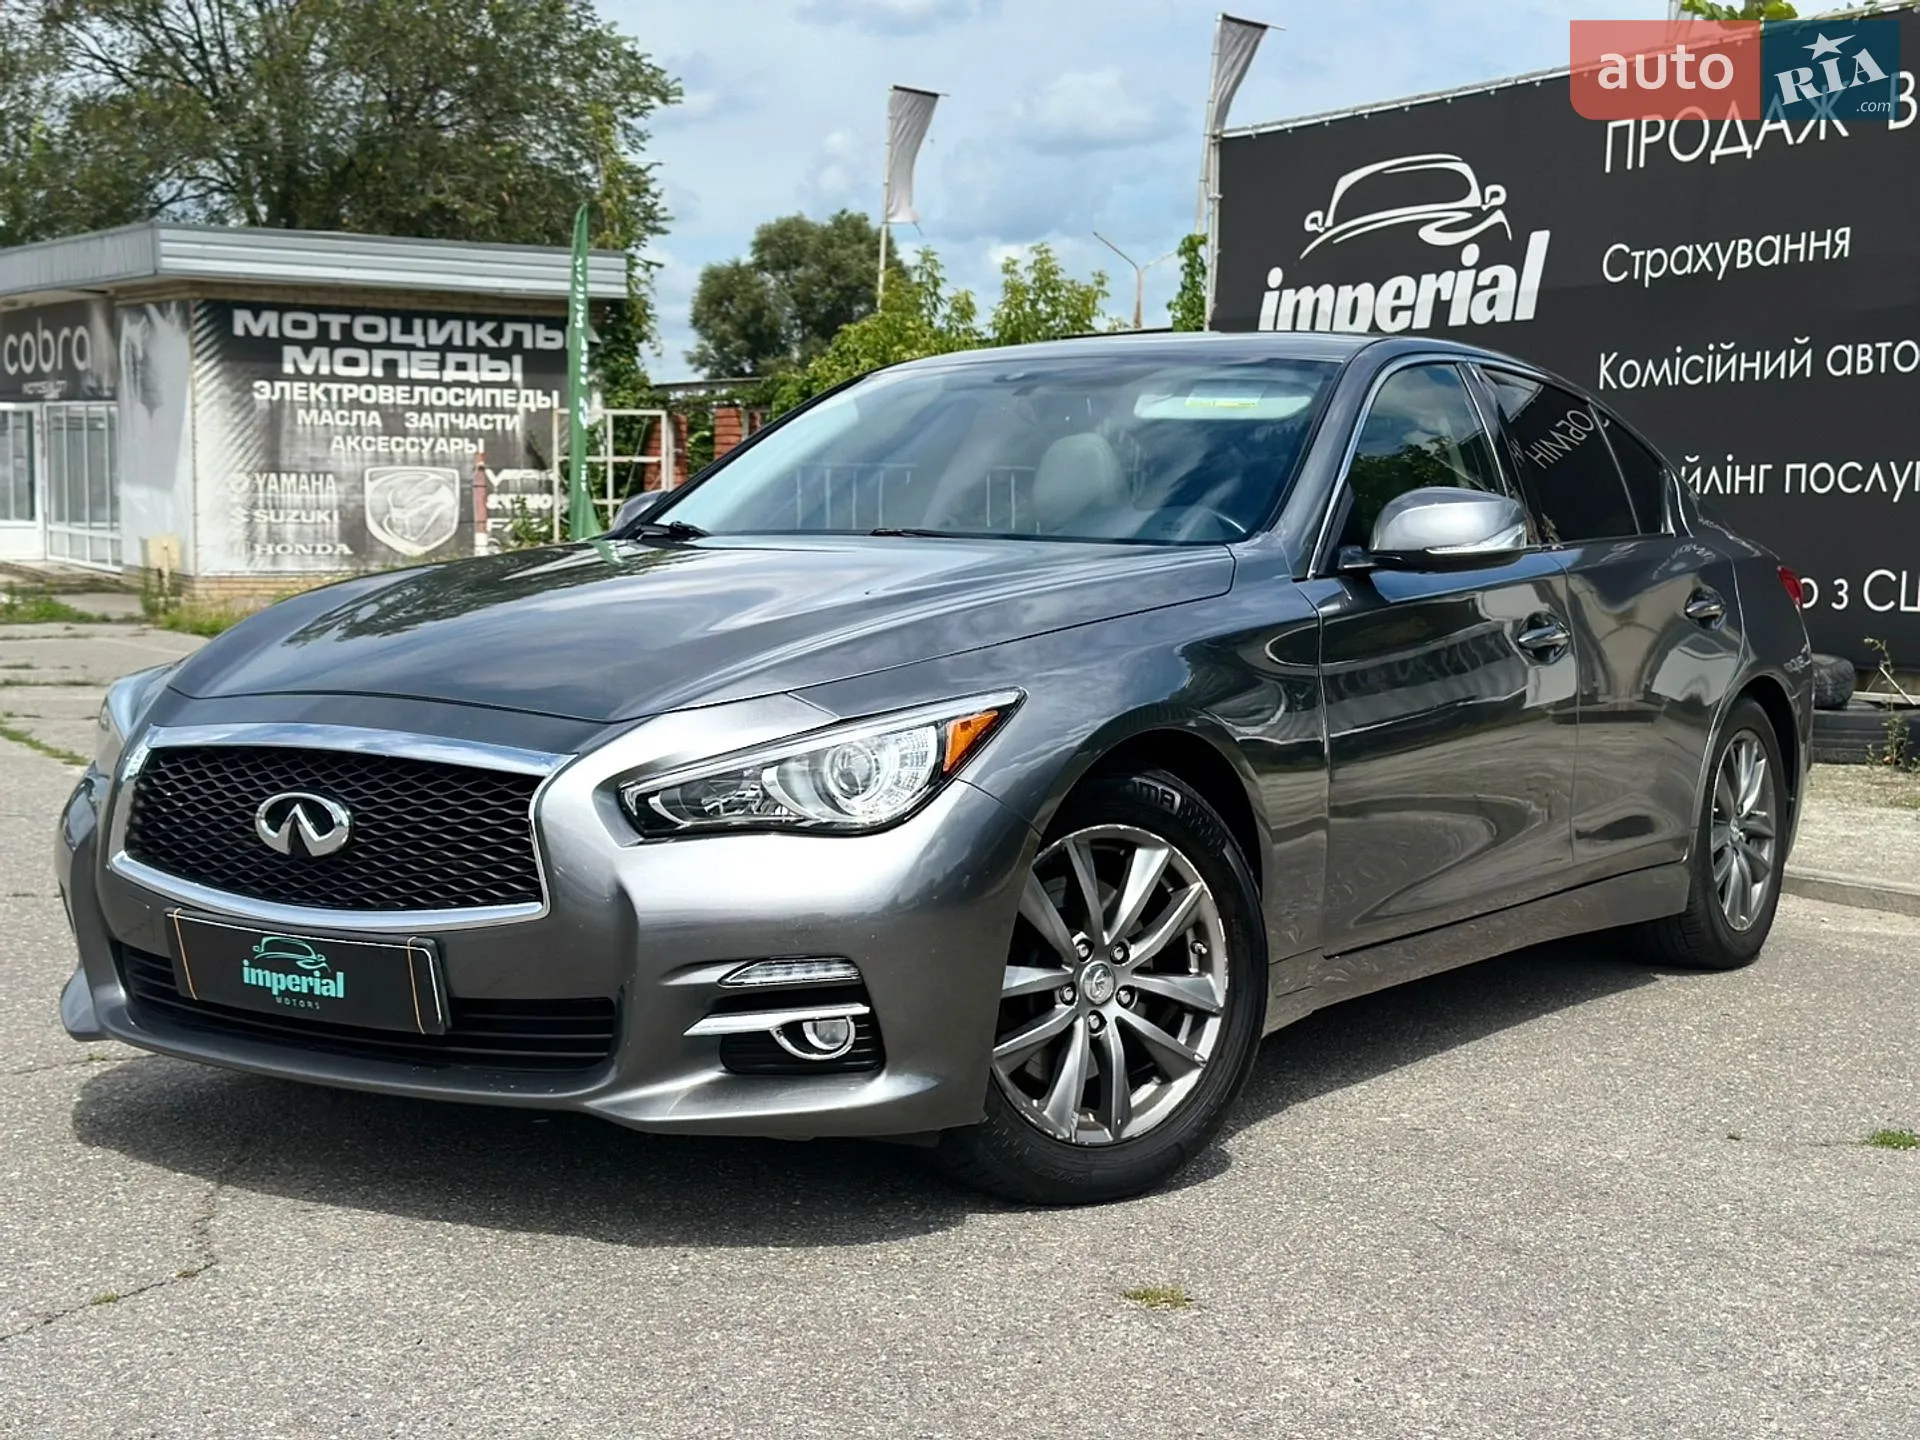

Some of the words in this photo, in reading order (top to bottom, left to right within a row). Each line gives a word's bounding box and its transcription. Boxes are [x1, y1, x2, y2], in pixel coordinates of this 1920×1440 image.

[1605, 81, 1849, 173] ПРОДАЖ
[1602, 227, 1851, 288] Страхування
[1258, 230, 1550, 333] imperial
[4, 317, 92, 376] cobra
[282, 345, 523, 383] МОПЕДЫ
[1599, 336, 1812, 390] Комісійний
[1826, 339, 1920, 376] авто
[253, 380, 560, 412] ЭЛЕКТРОВЕЛОСИПЕДЫ
[297, 409, 382, 427] МАСЛА
[405, 412, 520, 431] ЗАПЧАСТИ
[331, 436, 485, 454] АКСЕССУАРЫ
[254, 472, 336, 495] YAMAHA
[1681, 454, 1773, 494] йлінг
[1784, 461, 1920, 503] послу
[254, 509, 339, 523] SUZUKI
[255, 543, 354, 555] HONDA
[1800, 578, 1819, 609] о
[242, 959, 344, 998] imperial
